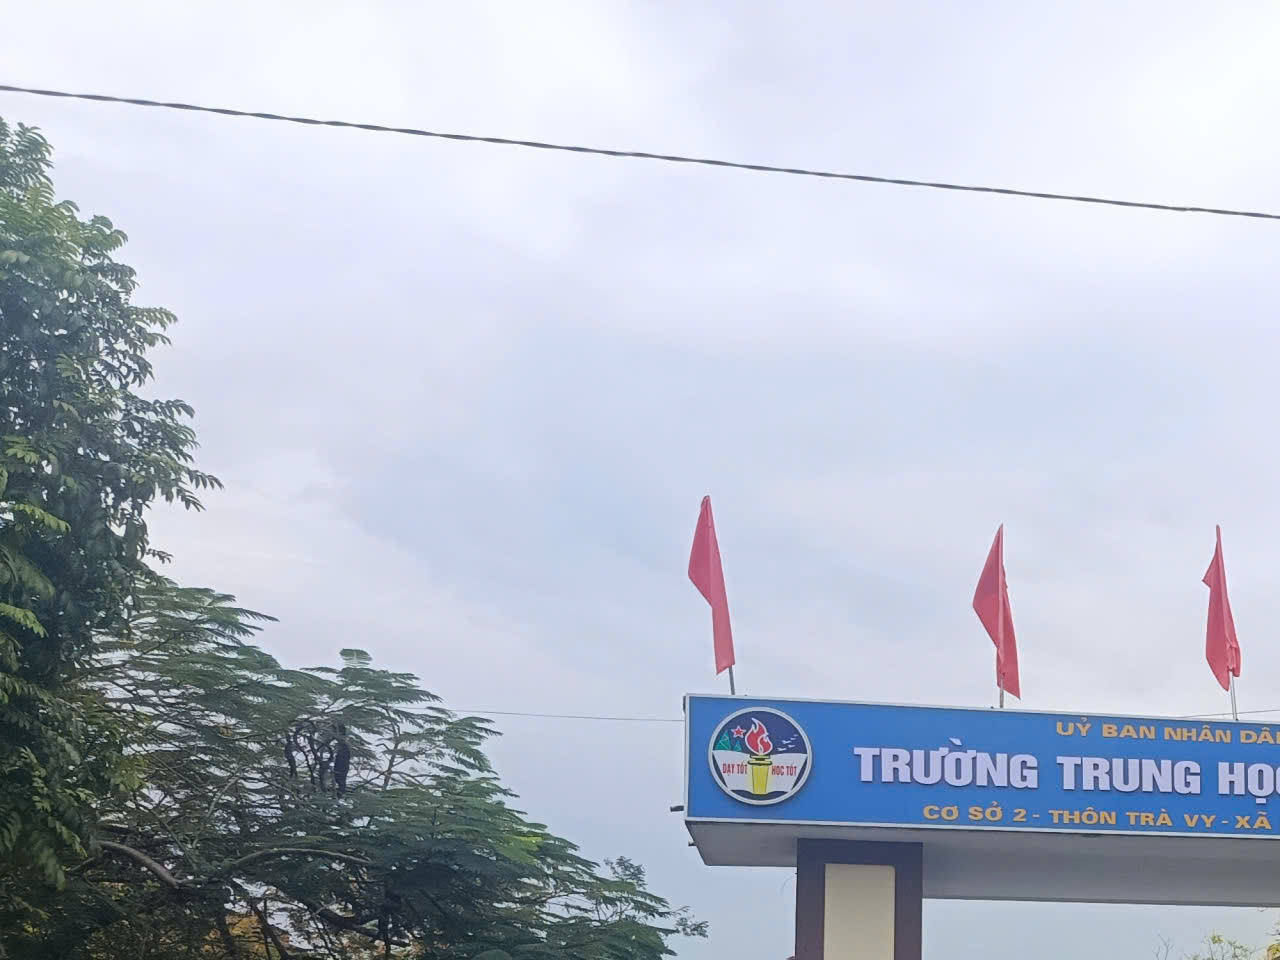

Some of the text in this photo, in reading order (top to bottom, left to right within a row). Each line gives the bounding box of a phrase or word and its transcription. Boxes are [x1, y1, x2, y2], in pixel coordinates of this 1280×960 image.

[1056, 717, 1092, 737] UỶ
[1102, 724, 1156, 740] BAN
[1164, 725, 1232, 744] NHÂN
[723, 761, 748, 777] DẠY TỐT
[854, 738, 1039, 789] TRƯỜNG
[1057, 756, 1201, 795] TRUNG
[923, 805, 959, 820] CƠ
[968, 801, 1004, 822] SỞ
[1013, 808, 1027, 822] 2
[1048, 807, 1117, 825] THÔN
[1125, 808, 1173, 826] TRÀ
[1183, 814, 1216, 828] VY
[1235, 811, 1272, 830] XÃ
